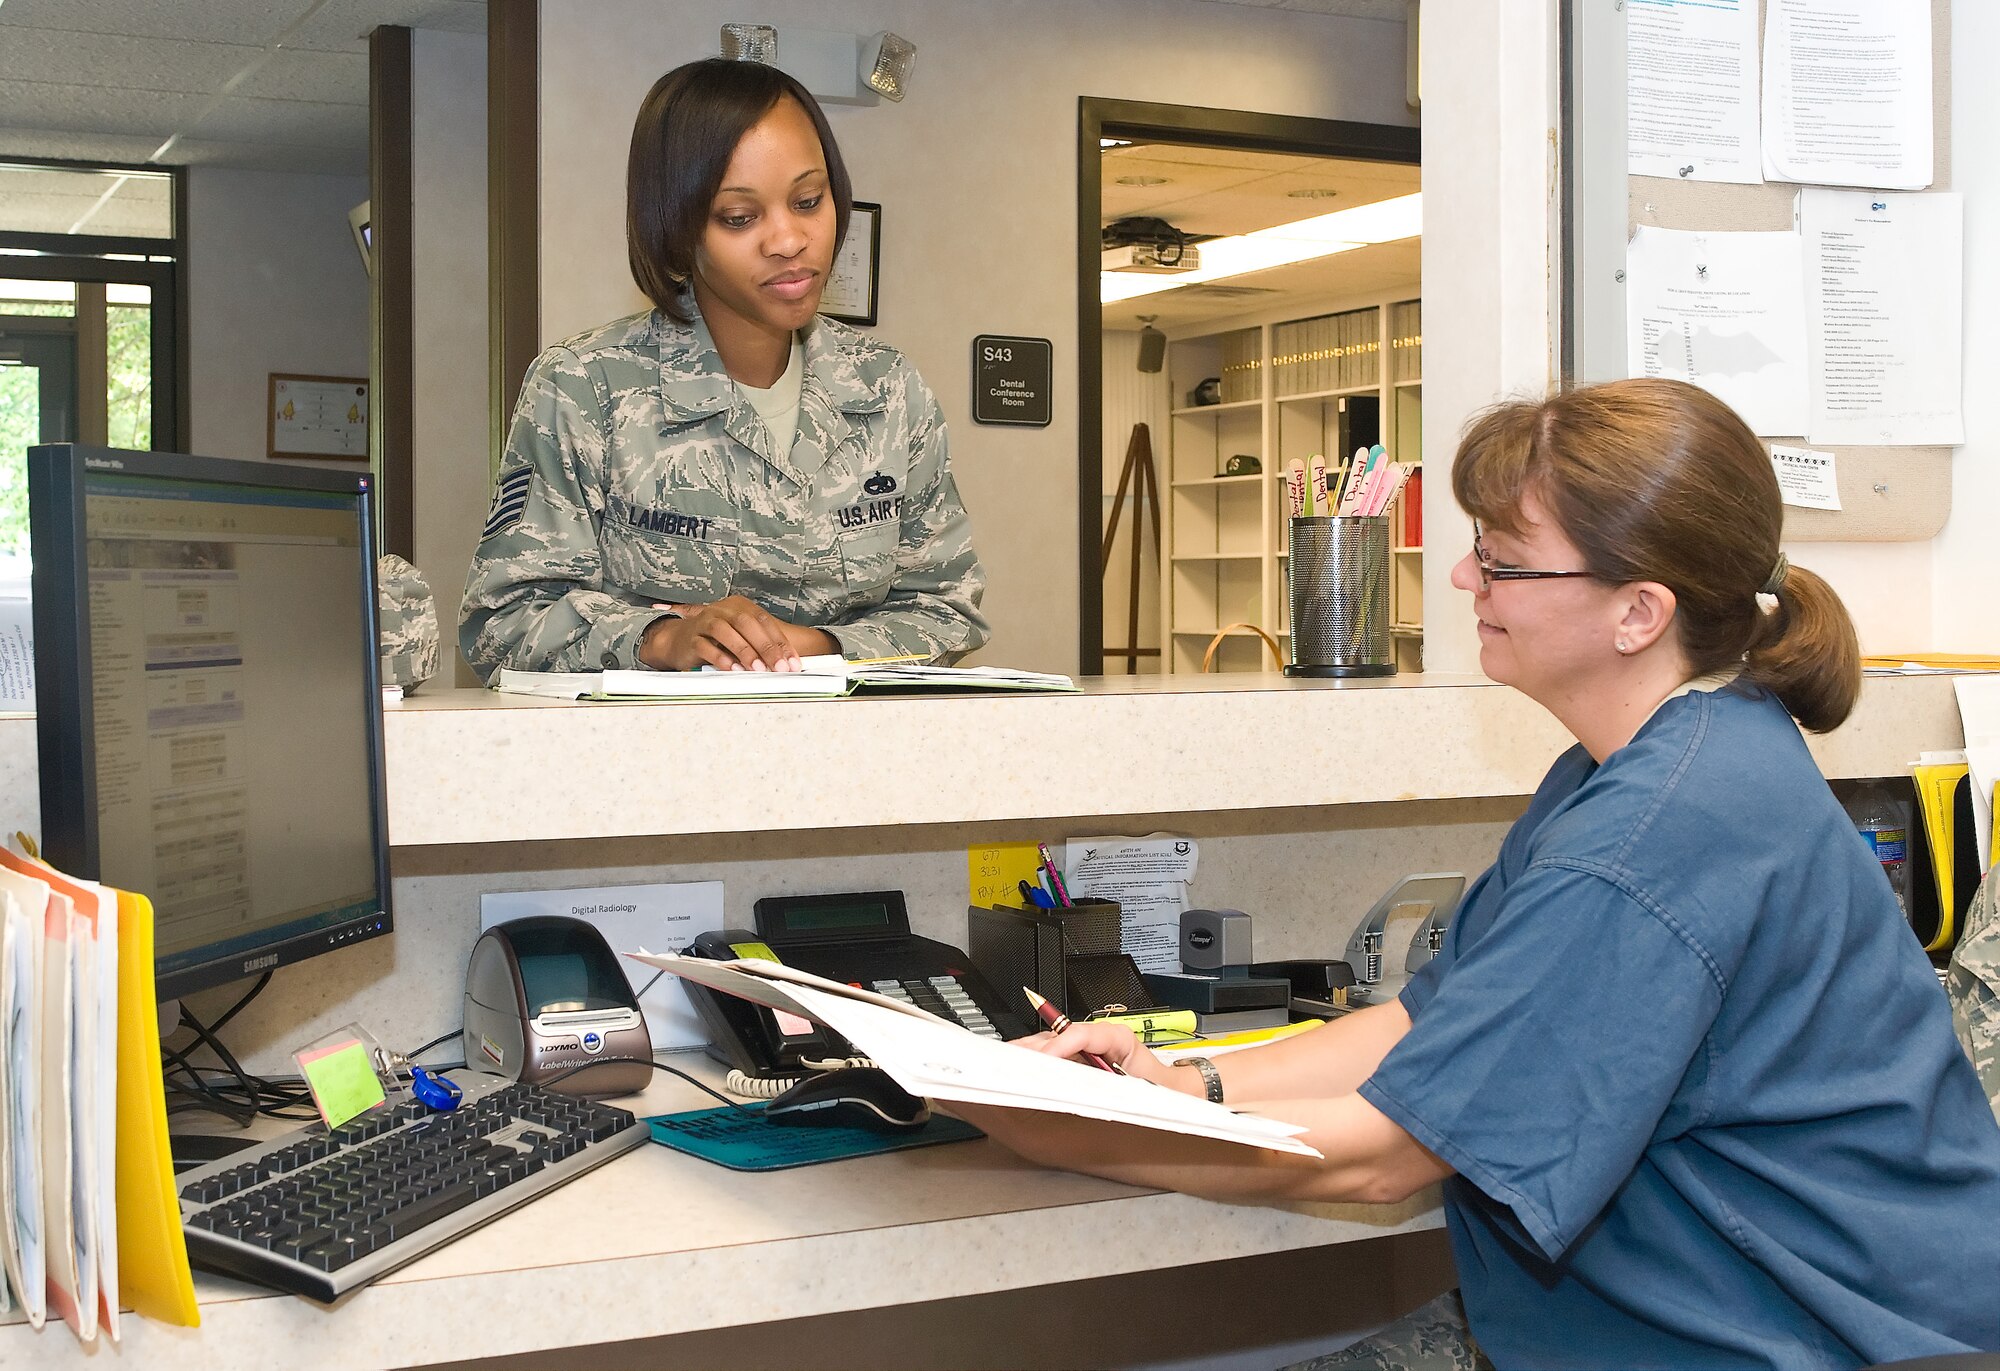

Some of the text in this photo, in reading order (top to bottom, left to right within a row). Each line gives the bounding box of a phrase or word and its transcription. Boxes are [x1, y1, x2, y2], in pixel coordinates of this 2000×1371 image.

[984, 346, 1012, 362] S43
[1000, 379, 1025, 388] Dental
[990, 388, 1035, 398] Conference
[1002, 397, 1025, 406] Room
[1313, 466, 1327, 502] Dental
[1344, 460, 1367, 501] Dental
[837, 505, 866, 528] U.S.
[869, 500, 893, 523] AIR
[628, 506, 712, 540] LAMBERT
[571, 903, 637, 915] Digital Radiology
[243, 953, 279, 973] SAMSUNG
[545, 1043, 578, 1052] DYMO
